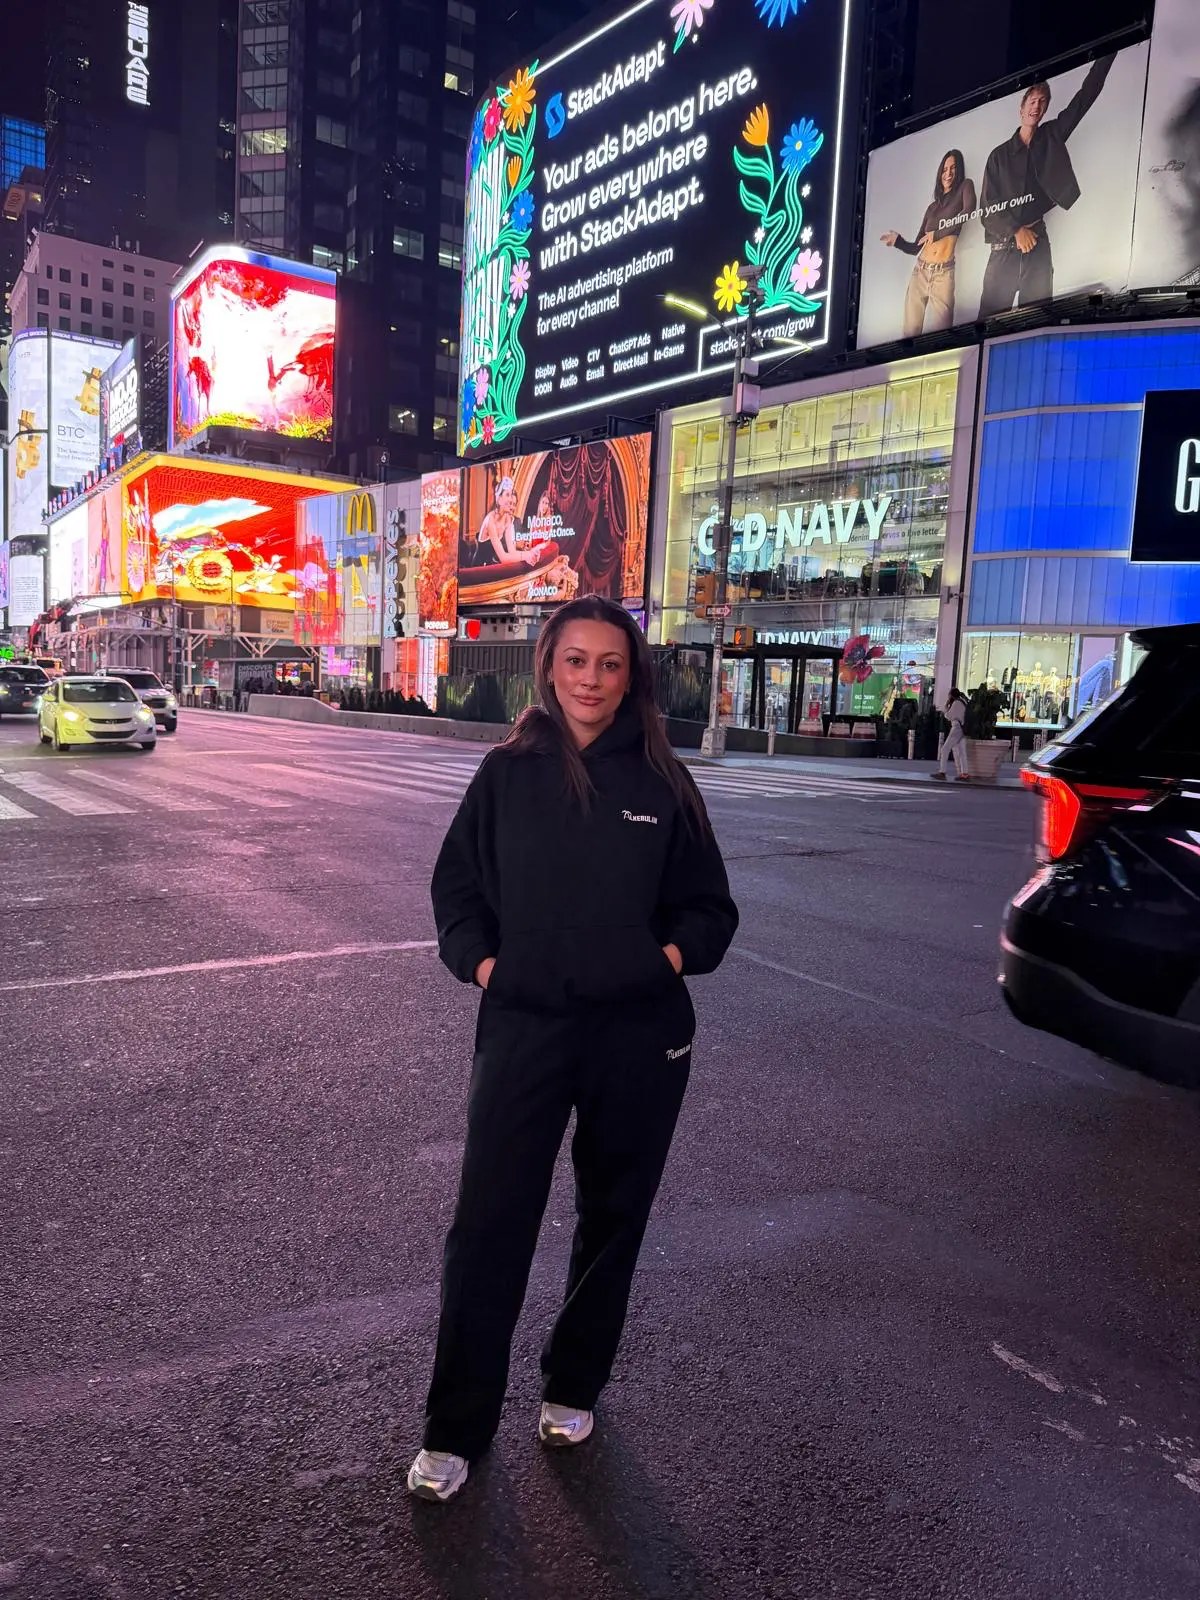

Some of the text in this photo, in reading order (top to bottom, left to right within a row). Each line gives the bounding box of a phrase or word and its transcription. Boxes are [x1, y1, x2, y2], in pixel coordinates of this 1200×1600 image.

[567, 40, 666, 119] StackAdapt
[543, 67, 758, 194] Your ads belong here.
[541, 134, 708, 232] Grow everywhere
[540, 176, 705, 270] with StackAdapt.
[938, 193, 1035, 231] Denim on your own.
[538, 247, 674, 311] The AI advertising platform
[537, 288, 620, 336] for every channel
[535, 323, 686, 380] Display Video CTV ChatGPT Ads Native
[560, 373, 578, 389] Audio
[586, 364, 605, 382] Email
[613, 356, 633, 374] Direct
[633, 351, 649, 368] Mail
[654, 343, 685, 361] In-Game
[57, 424, 85, 439] BTC
[556, 527, 576, 537] Once.
[775, 497, 893, 548] NAVY
